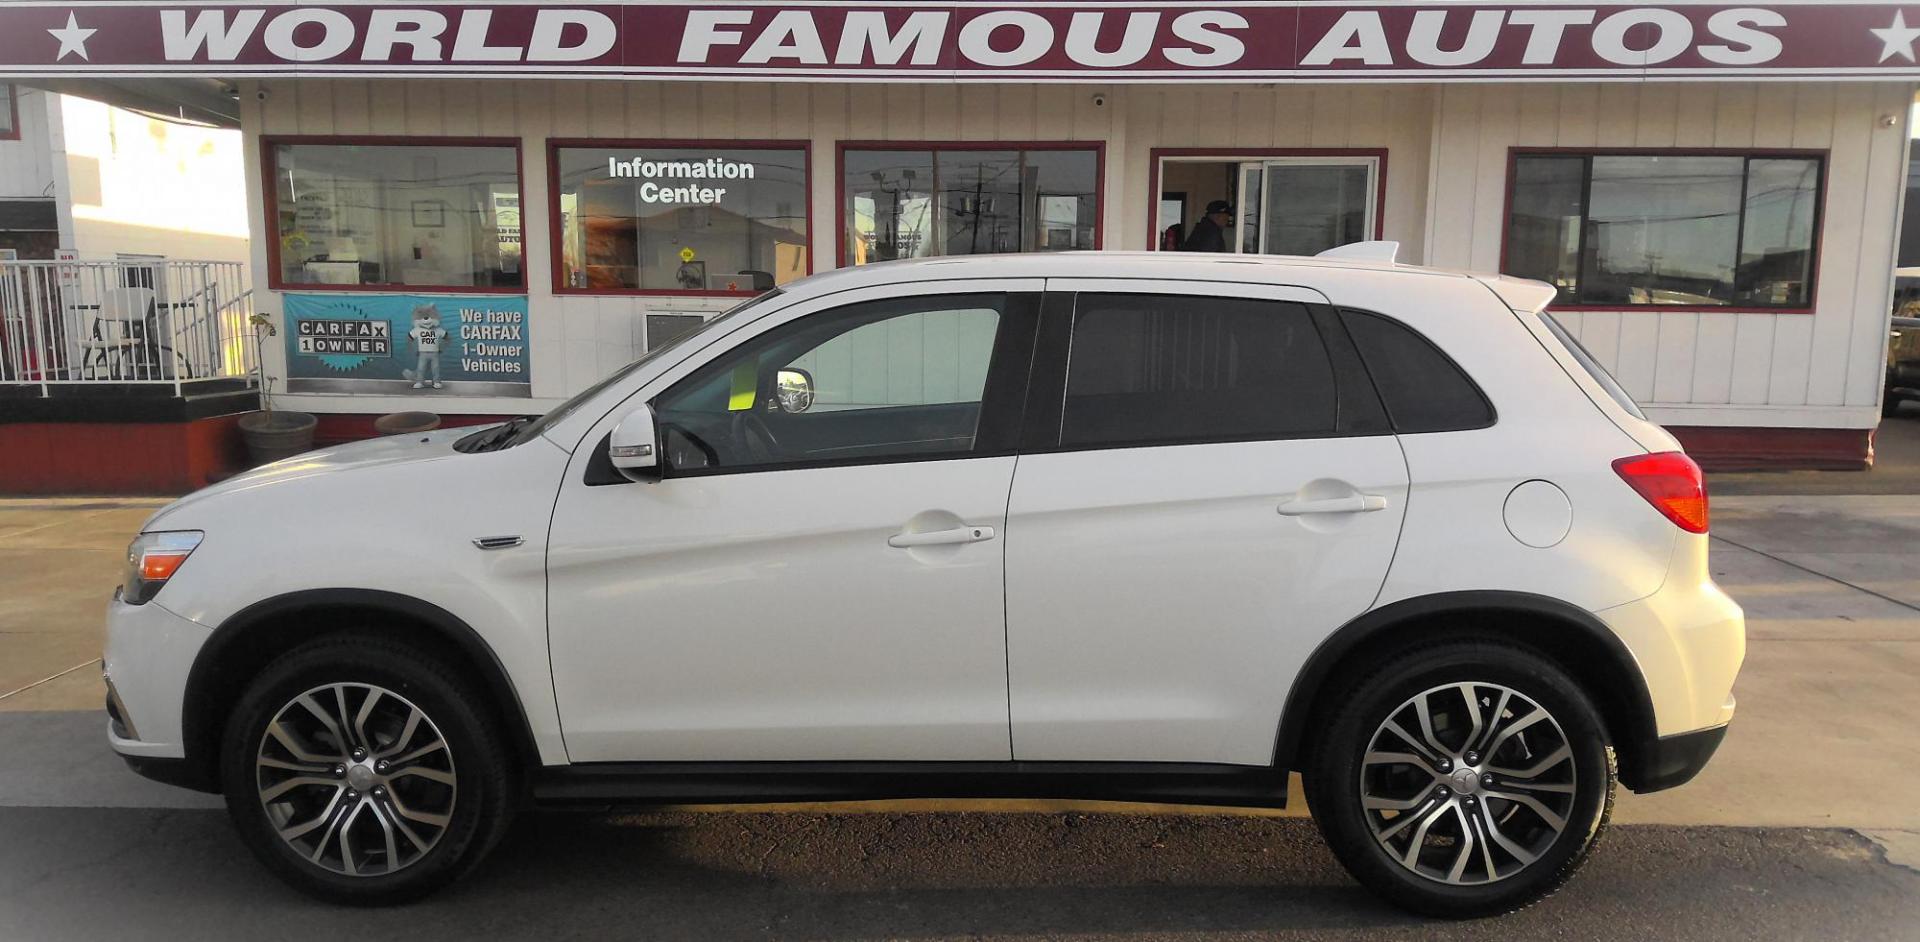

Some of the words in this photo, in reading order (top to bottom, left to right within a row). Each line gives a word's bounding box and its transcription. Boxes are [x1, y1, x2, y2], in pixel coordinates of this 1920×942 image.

[160, 8, 617, 62] WORLD
[676, 9, 1250, 67] FAMOUS
[1299, 7, 1788, 66] AUTOS
[609, 157, 754, 179] Information
[640, 182, 726, 204] Center
[460, 308, 482, 323] We
[487, 309, 522, 323] have
[300, 322, 384, 337] CARFAX
[461, 325, 521, 340] CARFAX
[302, 340, 311, 351] 1
[316, 340, 385, 352] OWNER
[461, 342, 522, 357] 1-Owner
[461, 358, 521, 373] Vehicles
